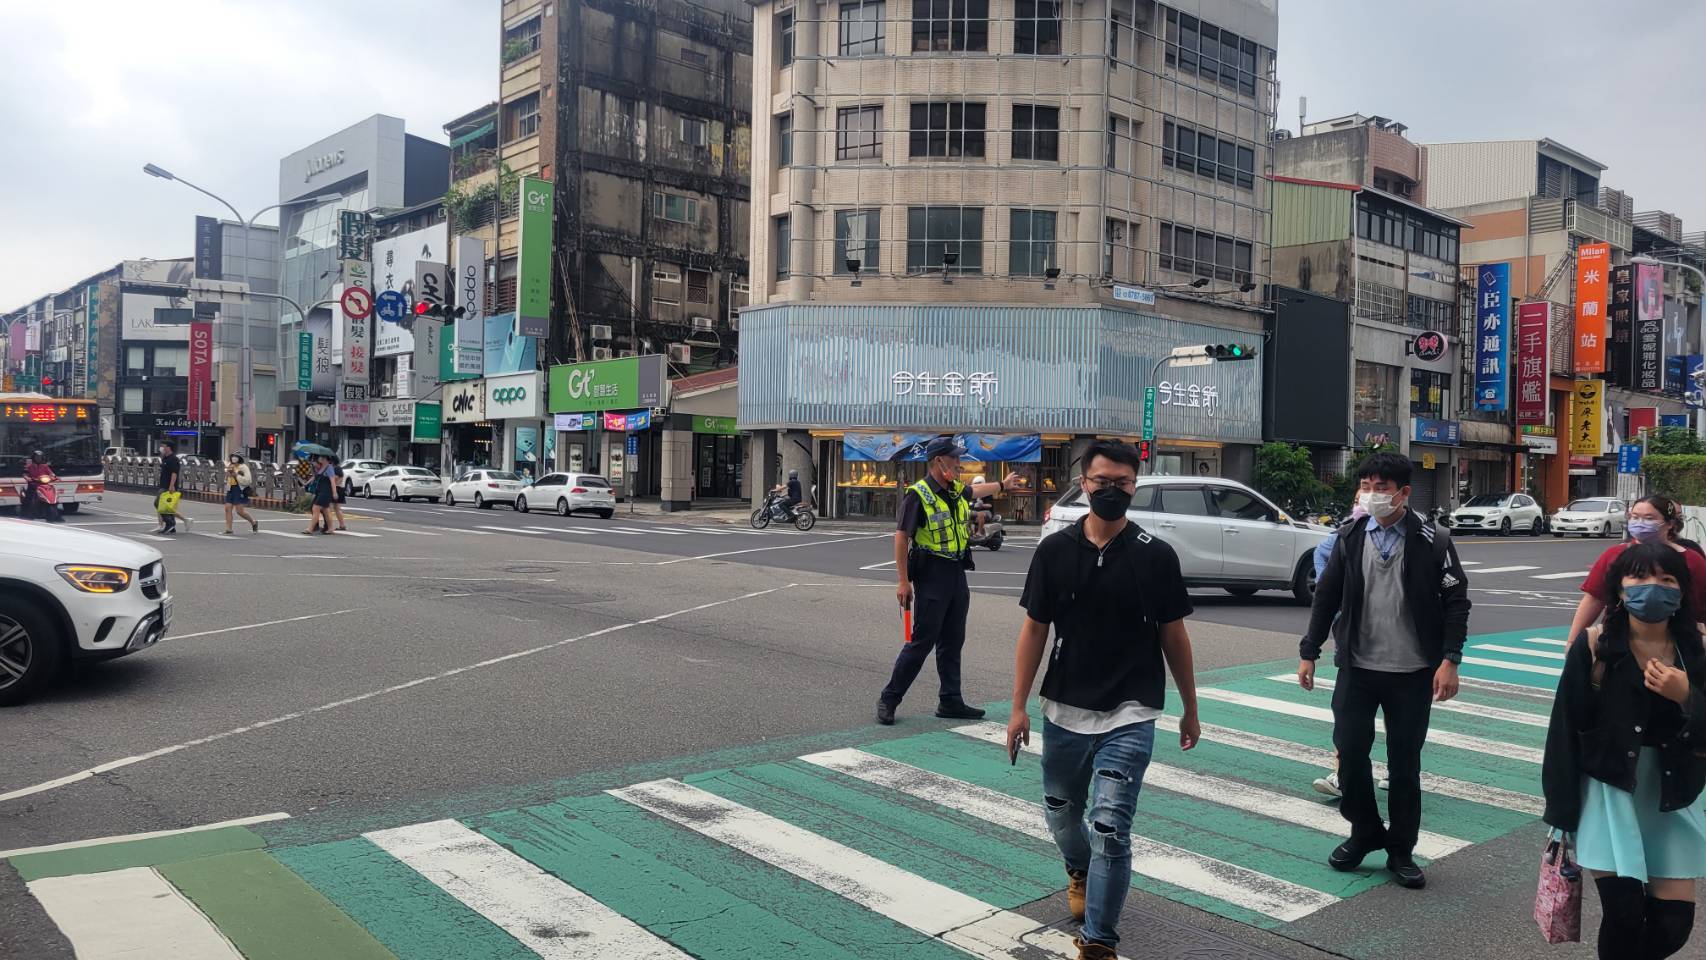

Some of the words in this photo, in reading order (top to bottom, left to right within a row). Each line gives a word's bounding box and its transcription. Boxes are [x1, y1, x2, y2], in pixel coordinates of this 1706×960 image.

[1580, 247, 1606, 257] Milan
[1581, 268, 1601, 348] 米蘭站
[194, 330, 208, 365] SOTA
[1481, 290, 1501, 375] 臣亦通訊
[1521, 312, 1544, 403] 二手旗艦
[492, 386, 526, 406] oppo
[891, 370, 998, 405] 今生金飾
[1158, 381, 1219, 417] 今生金飾
